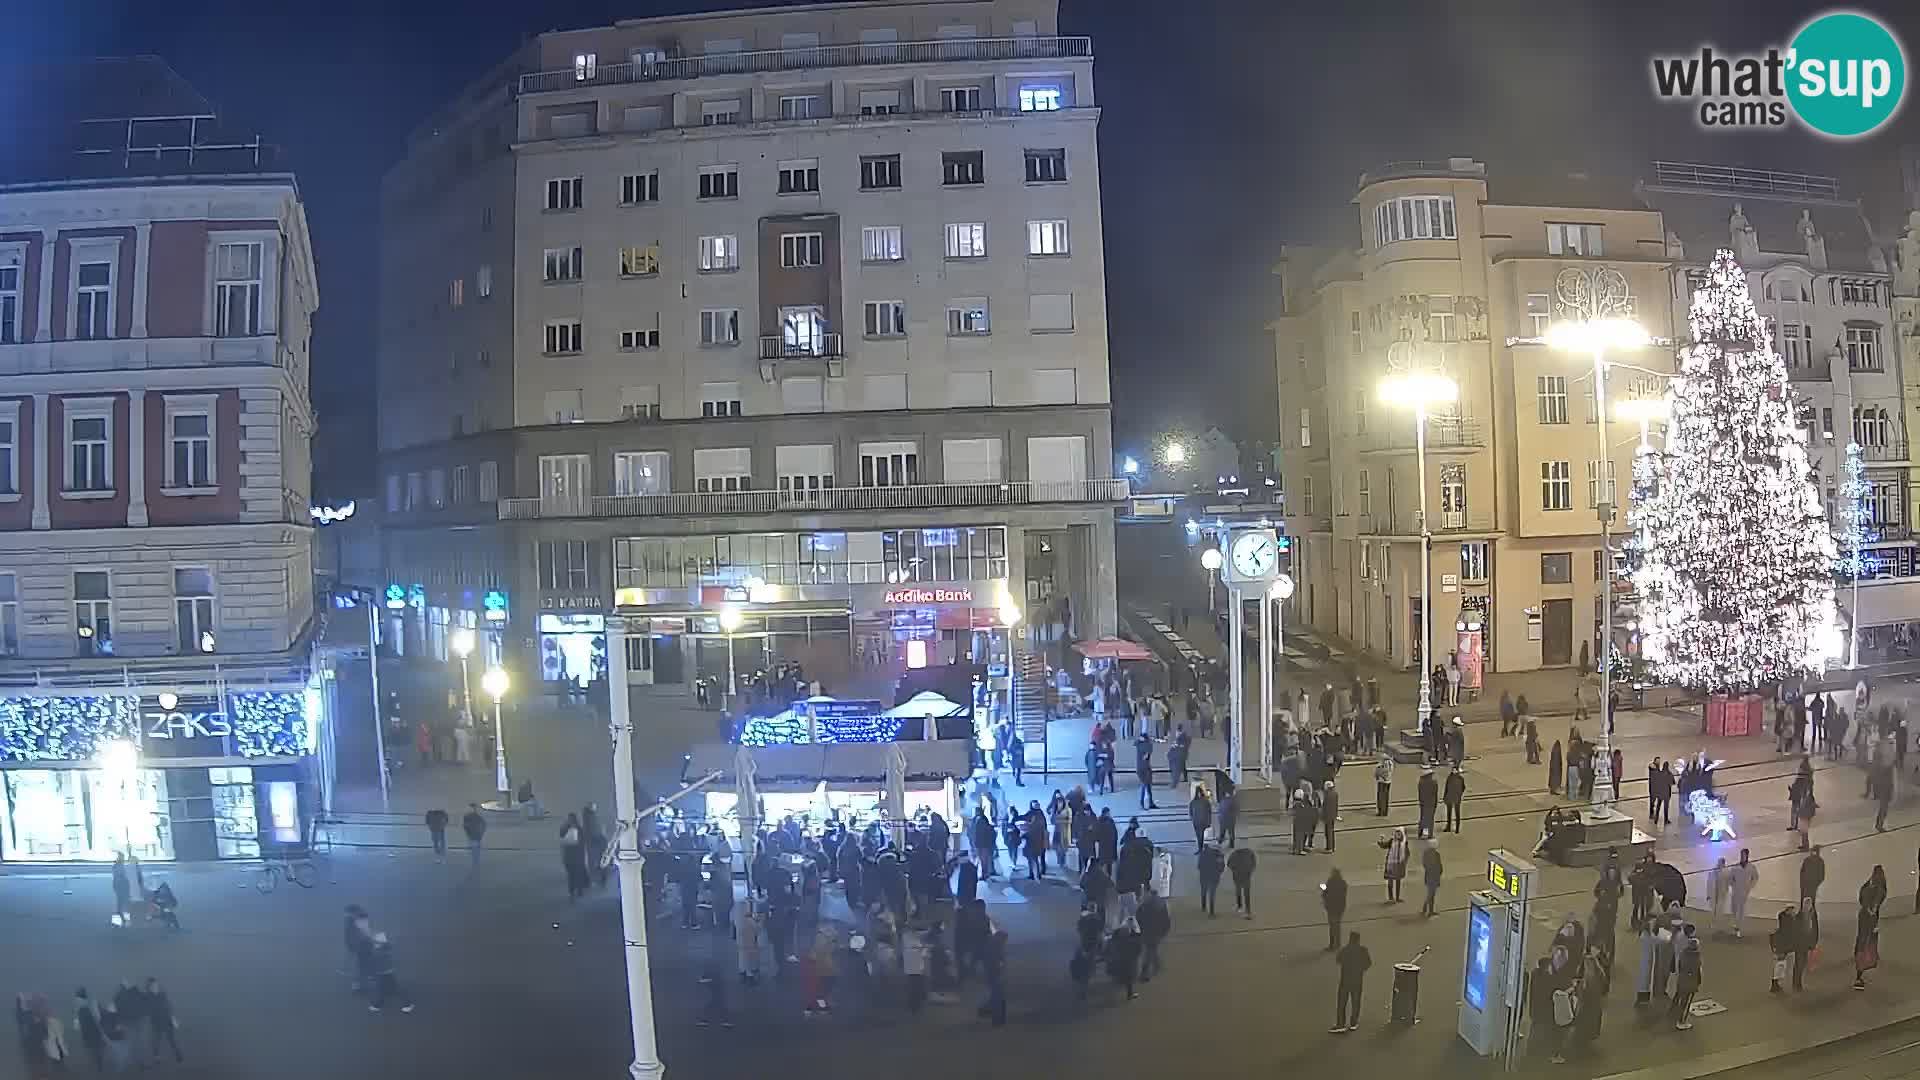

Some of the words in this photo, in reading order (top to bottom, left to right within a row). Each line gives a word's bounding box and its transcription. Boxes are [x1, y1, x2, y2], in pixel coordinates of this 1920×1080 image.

[885, 590, 934, 603] Addiko
[935, 588, 972, 601] Bank
[145, 712, 231, 738] ZAKS
